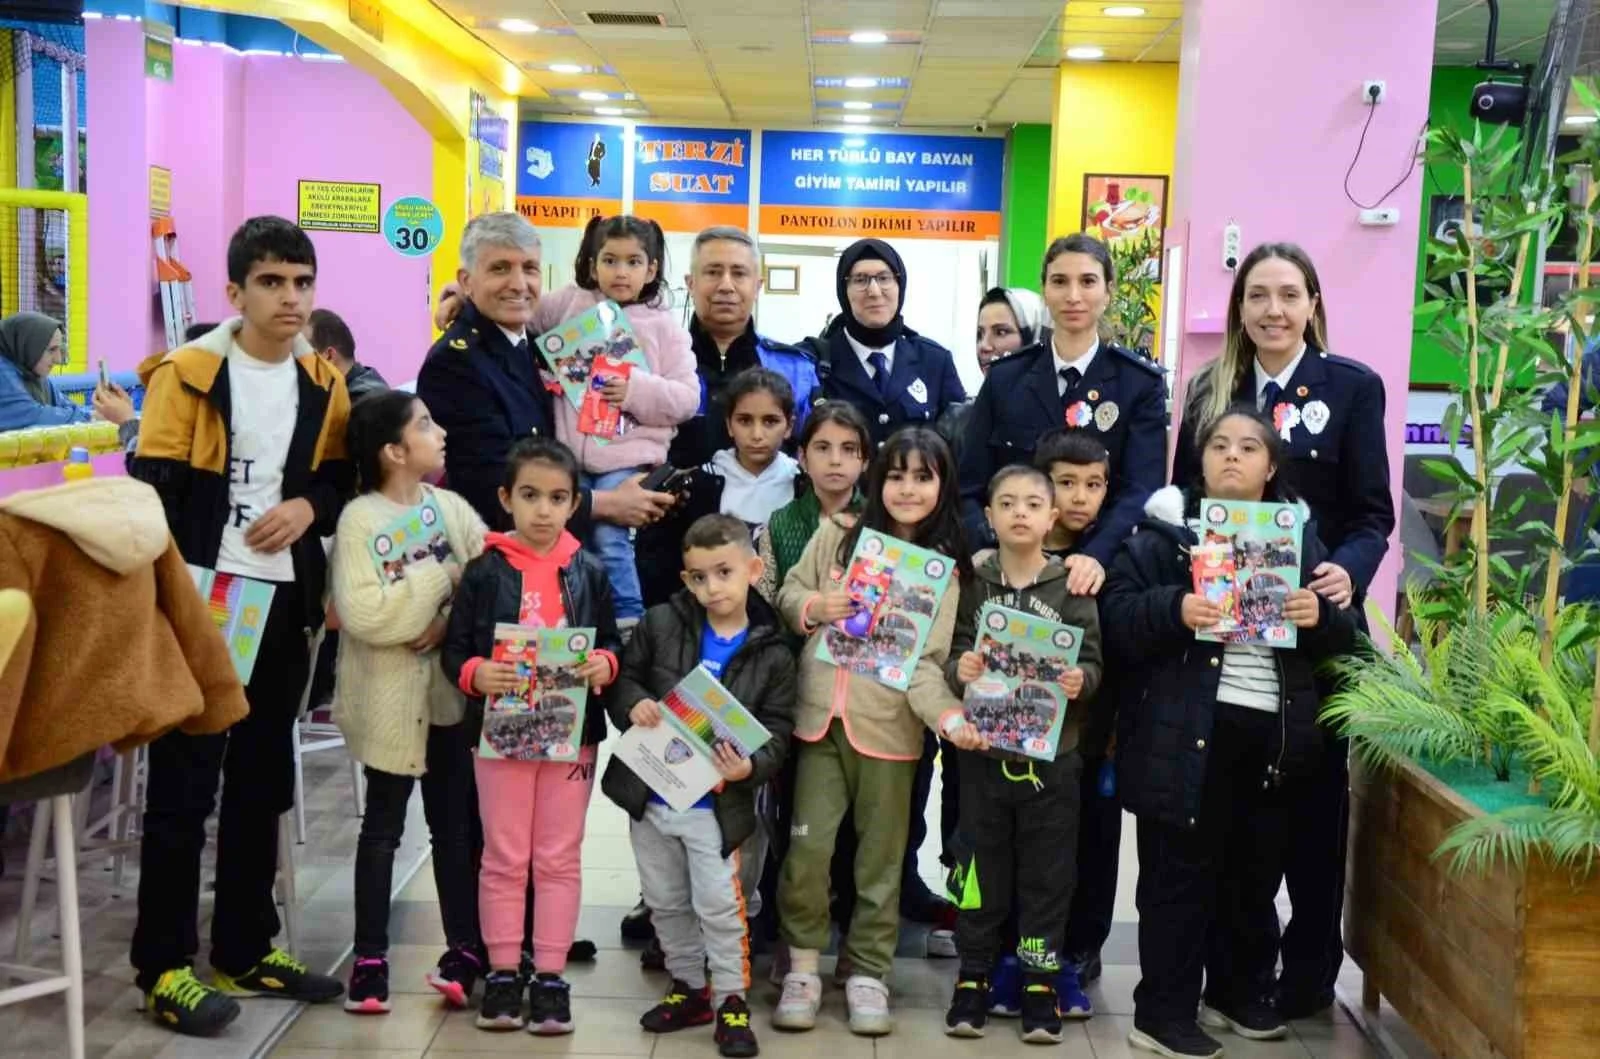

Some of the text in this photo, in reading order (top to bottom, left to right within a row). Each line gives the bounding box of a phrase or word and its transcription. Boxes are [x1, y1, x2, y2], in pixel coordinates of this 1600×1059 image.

[640, 138, 744, 167] TERZİ
[791, 148, 824, 162] HER
[885, 151, 916, 166] BAY
[921, 152, 974, 167] BAYAN
[649, 172, 734, 195] SUAT
[794, 173, 968, 194] GİYİM TAMİRİ YAPILIR
[780, 214, 976, 233] PANTOLON DİKİMİ YAPILIR
[395, 227, 429, 250] 30
